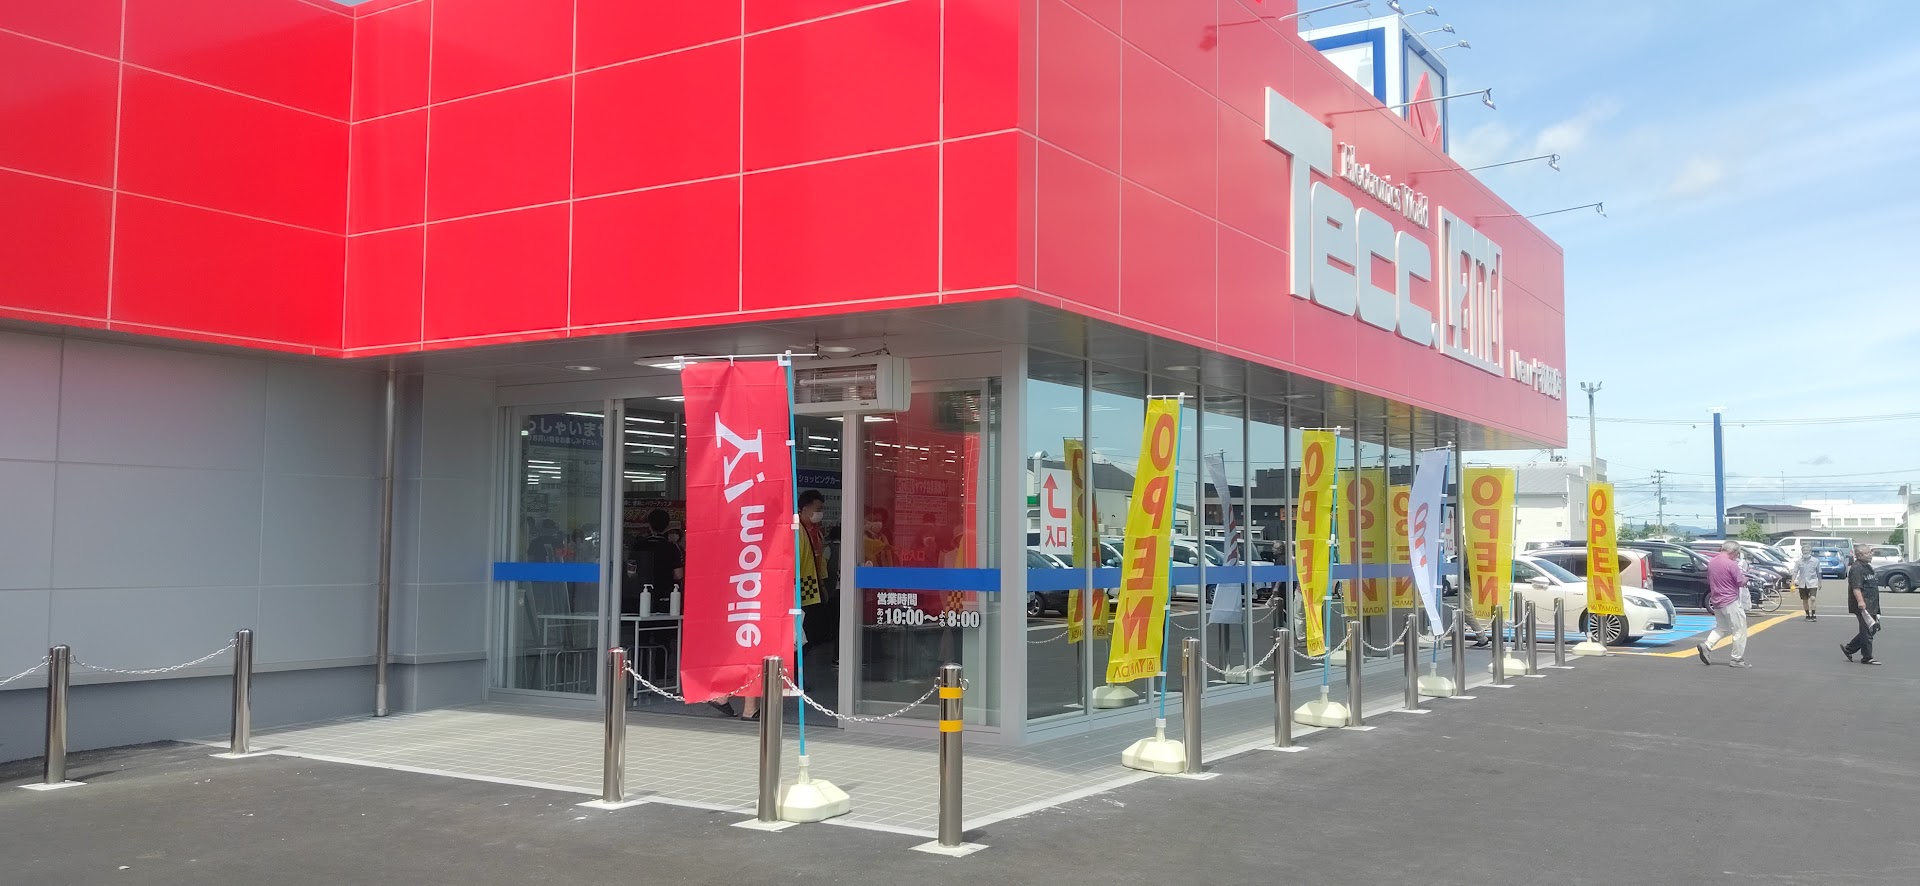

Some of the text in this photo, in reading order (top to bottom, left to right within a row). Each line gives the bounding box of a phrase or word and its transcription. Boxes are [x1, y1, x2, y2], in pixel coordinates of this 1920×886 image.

[1045, 525, 1068, 547] 入口
[1591, 489, 1617, 601] OPEN
[877, 592, 918, 606] 営業時間
